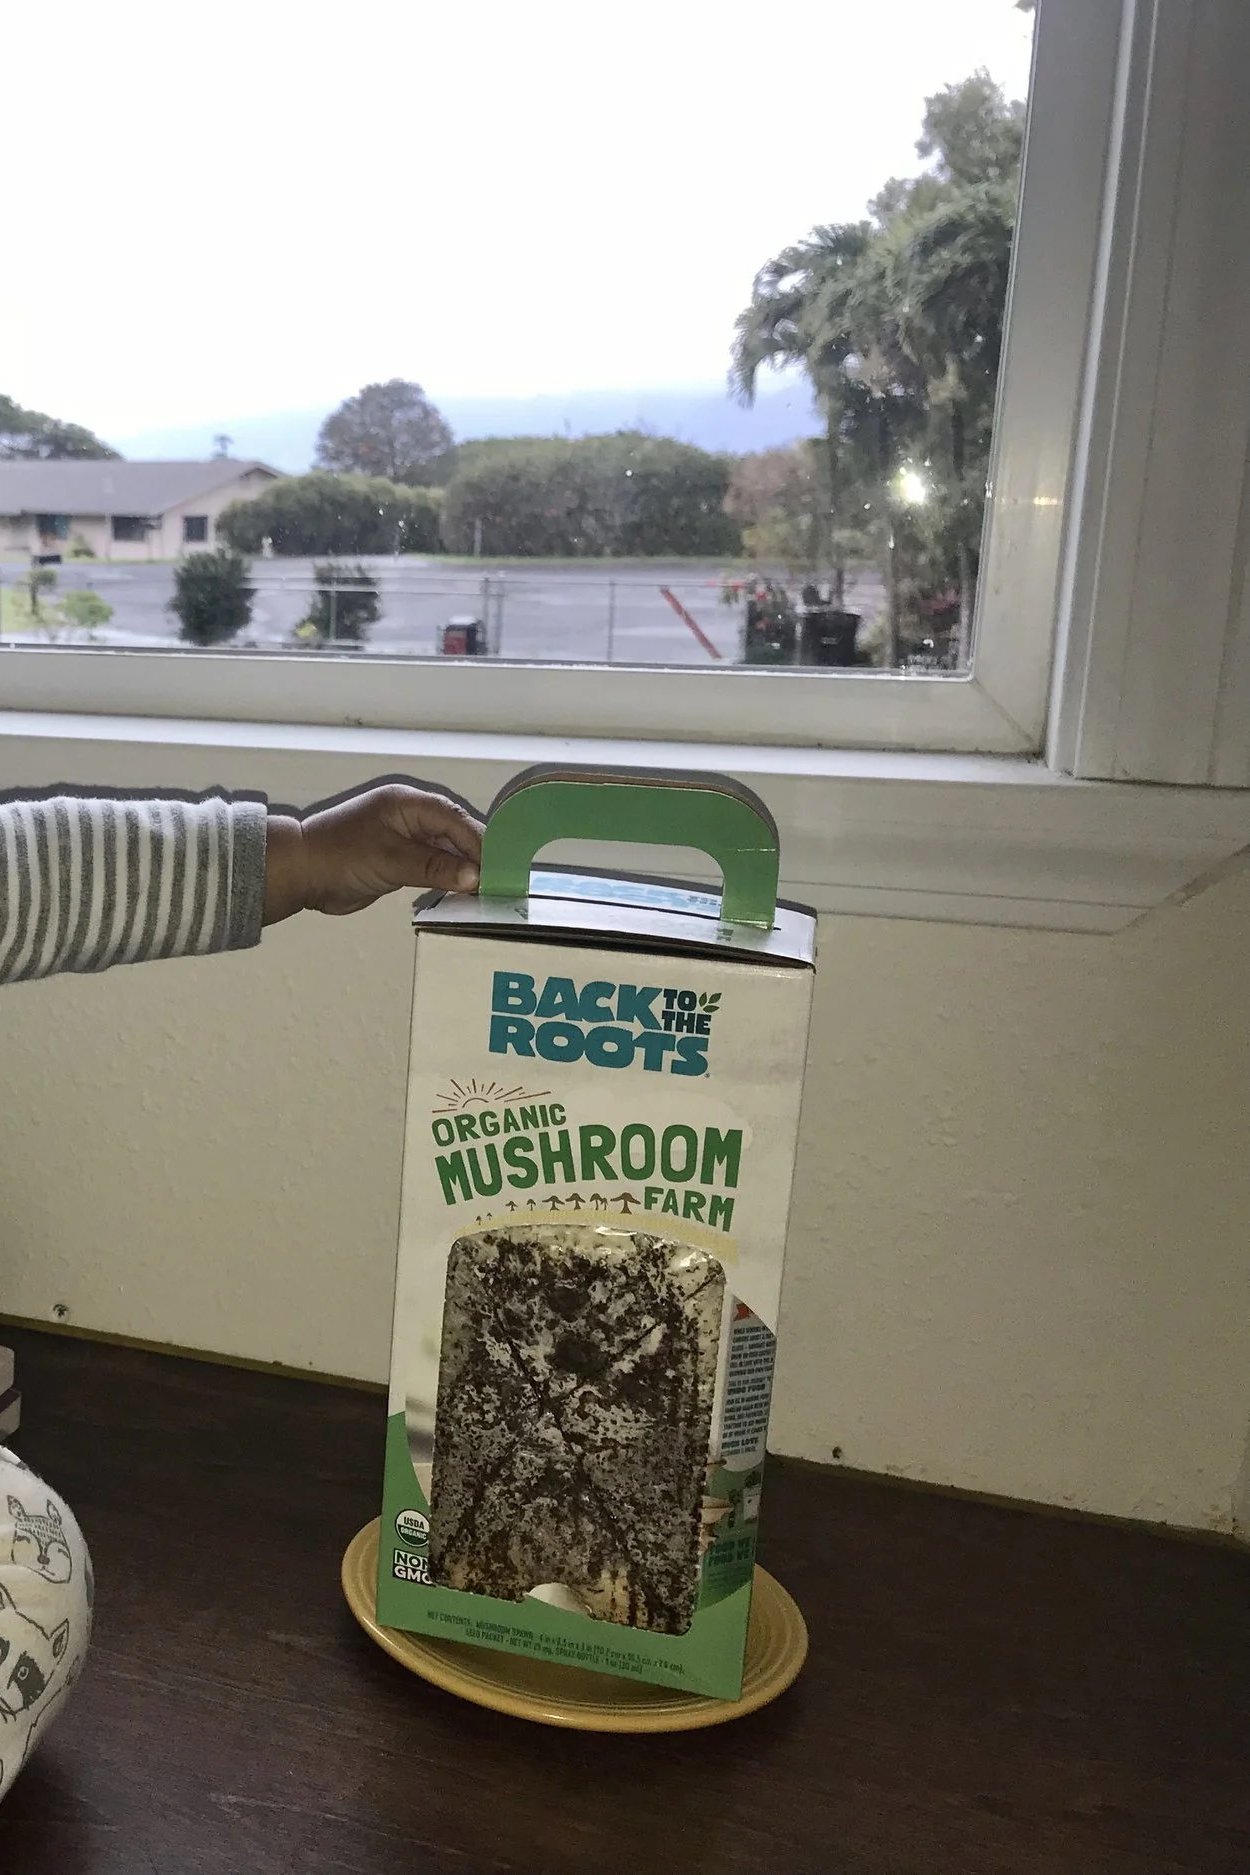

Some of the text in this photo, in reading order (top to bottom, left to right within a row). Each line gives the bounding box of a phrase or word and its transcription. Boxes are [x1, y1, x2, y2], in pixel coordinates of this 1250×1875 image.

[492, 971, 711, 1035] BACK TO THE
[488, 1015, 710, 1077] ROOTS
[431, 1103, 567, 1147] ORGANIC
[434, 1123, 743, 1206] MUSHROOM
[643, 1186, 735, 1232] FARM
[400, 1526, 427, 1540] ORGANIC
[404, 1516, 425, 1530] USDA
